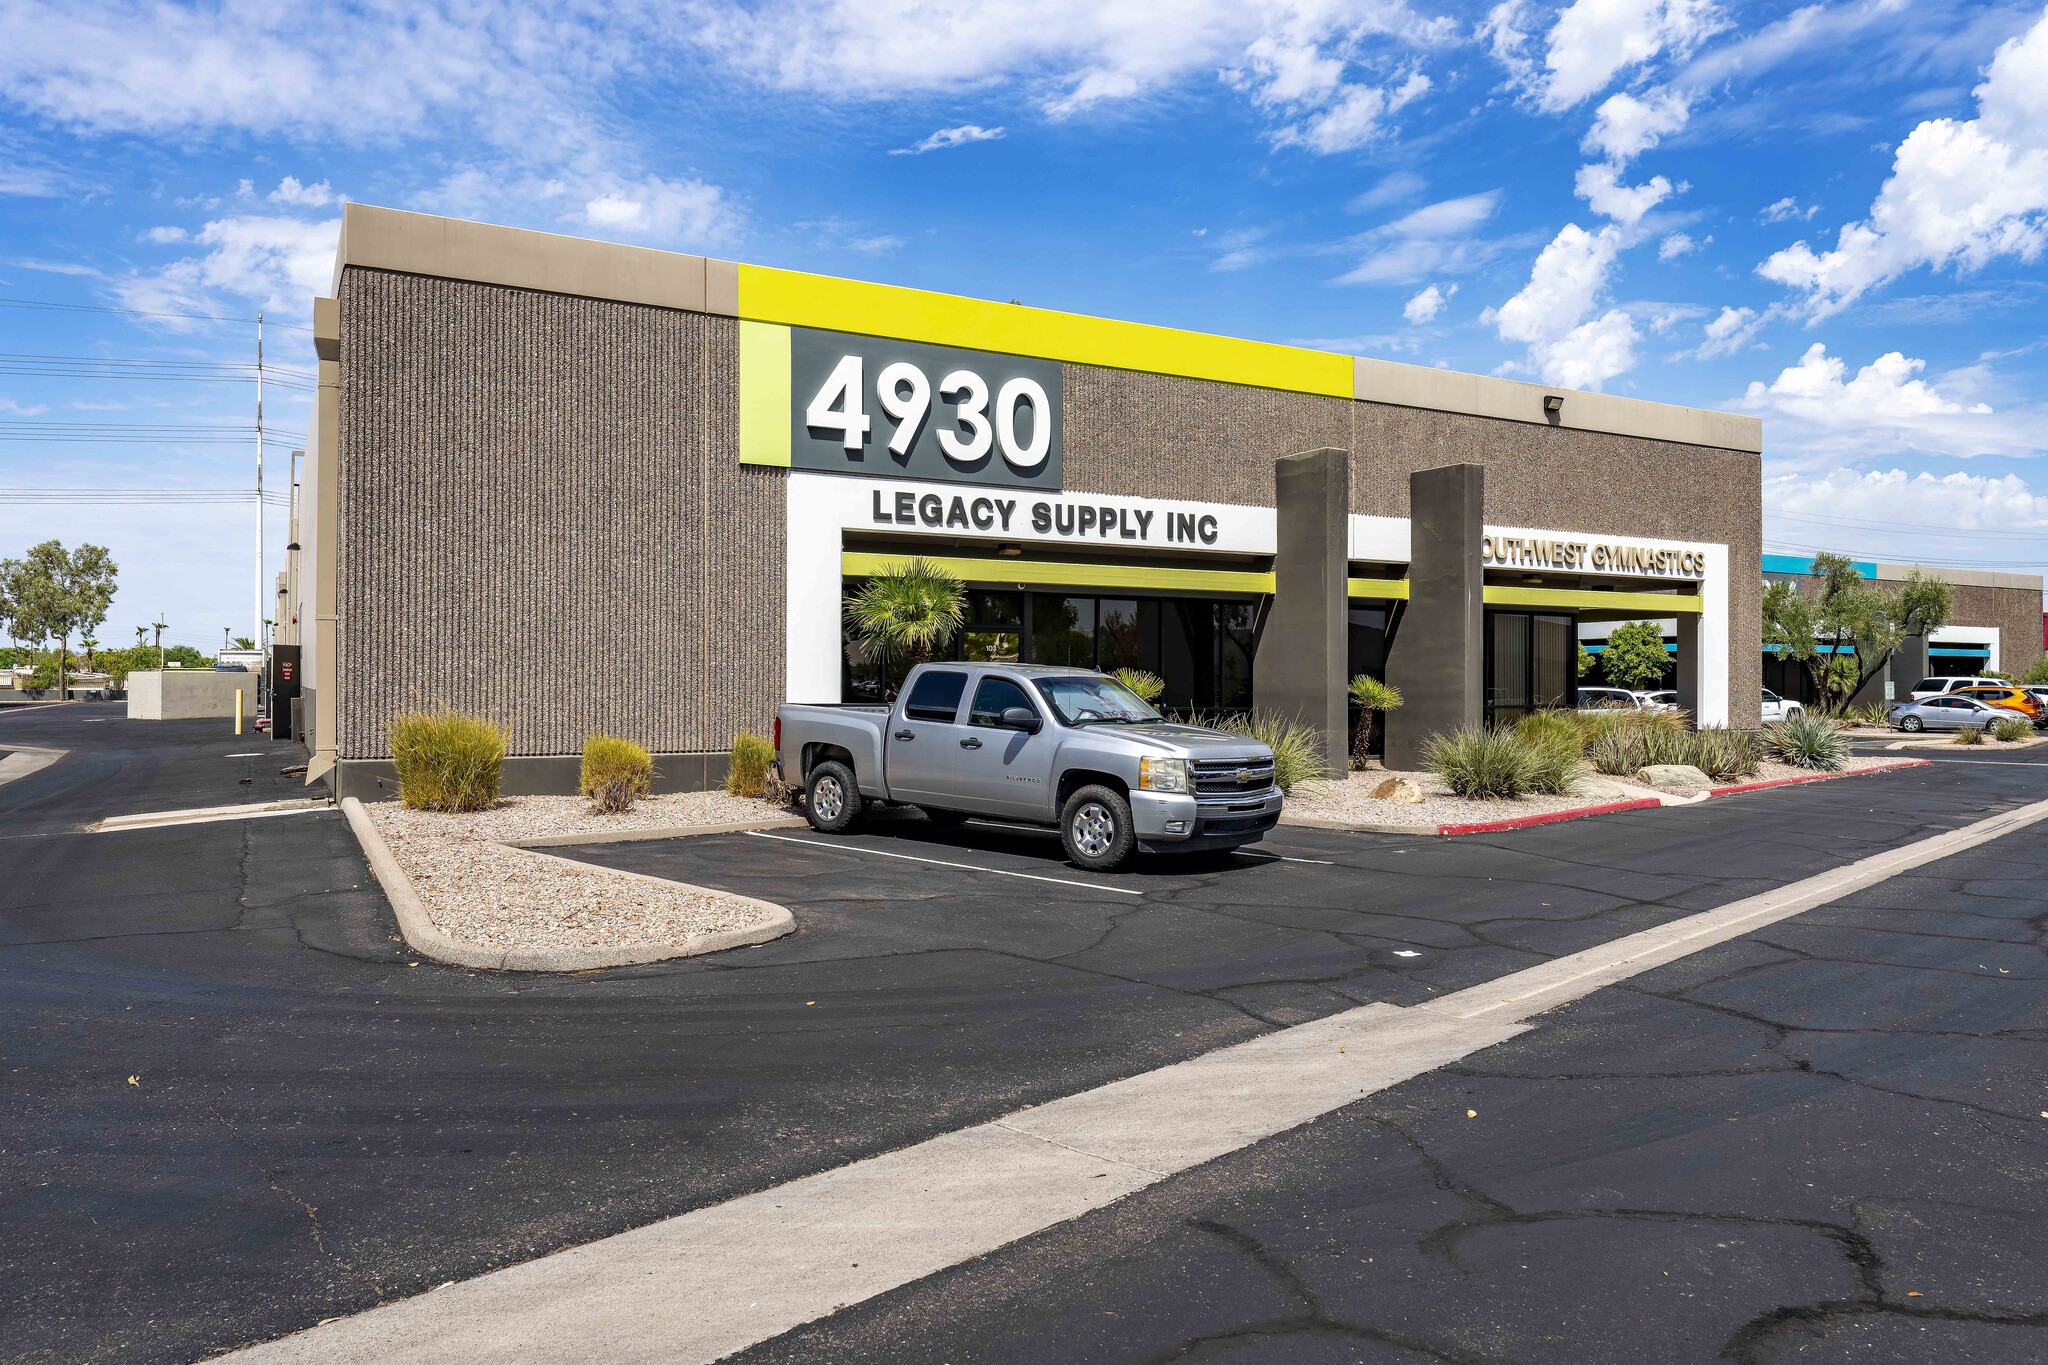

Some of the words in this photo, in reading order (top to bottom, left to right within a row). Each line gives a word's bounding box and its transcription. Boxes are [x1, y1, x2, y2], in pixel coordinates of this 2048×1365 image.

[806, 355, 1052, 467] 4930
[872, 490, 1016, 531] LEGACY
[1031, 502, 1154, 540] SUPPLY
[1166, 511, 1219, 544] INC
[1482, 534, 1588, 565] OUTHWEST
[1591, 543, 1707, 574] GYMNASTICS
[985, 644, 997, 653] 103
